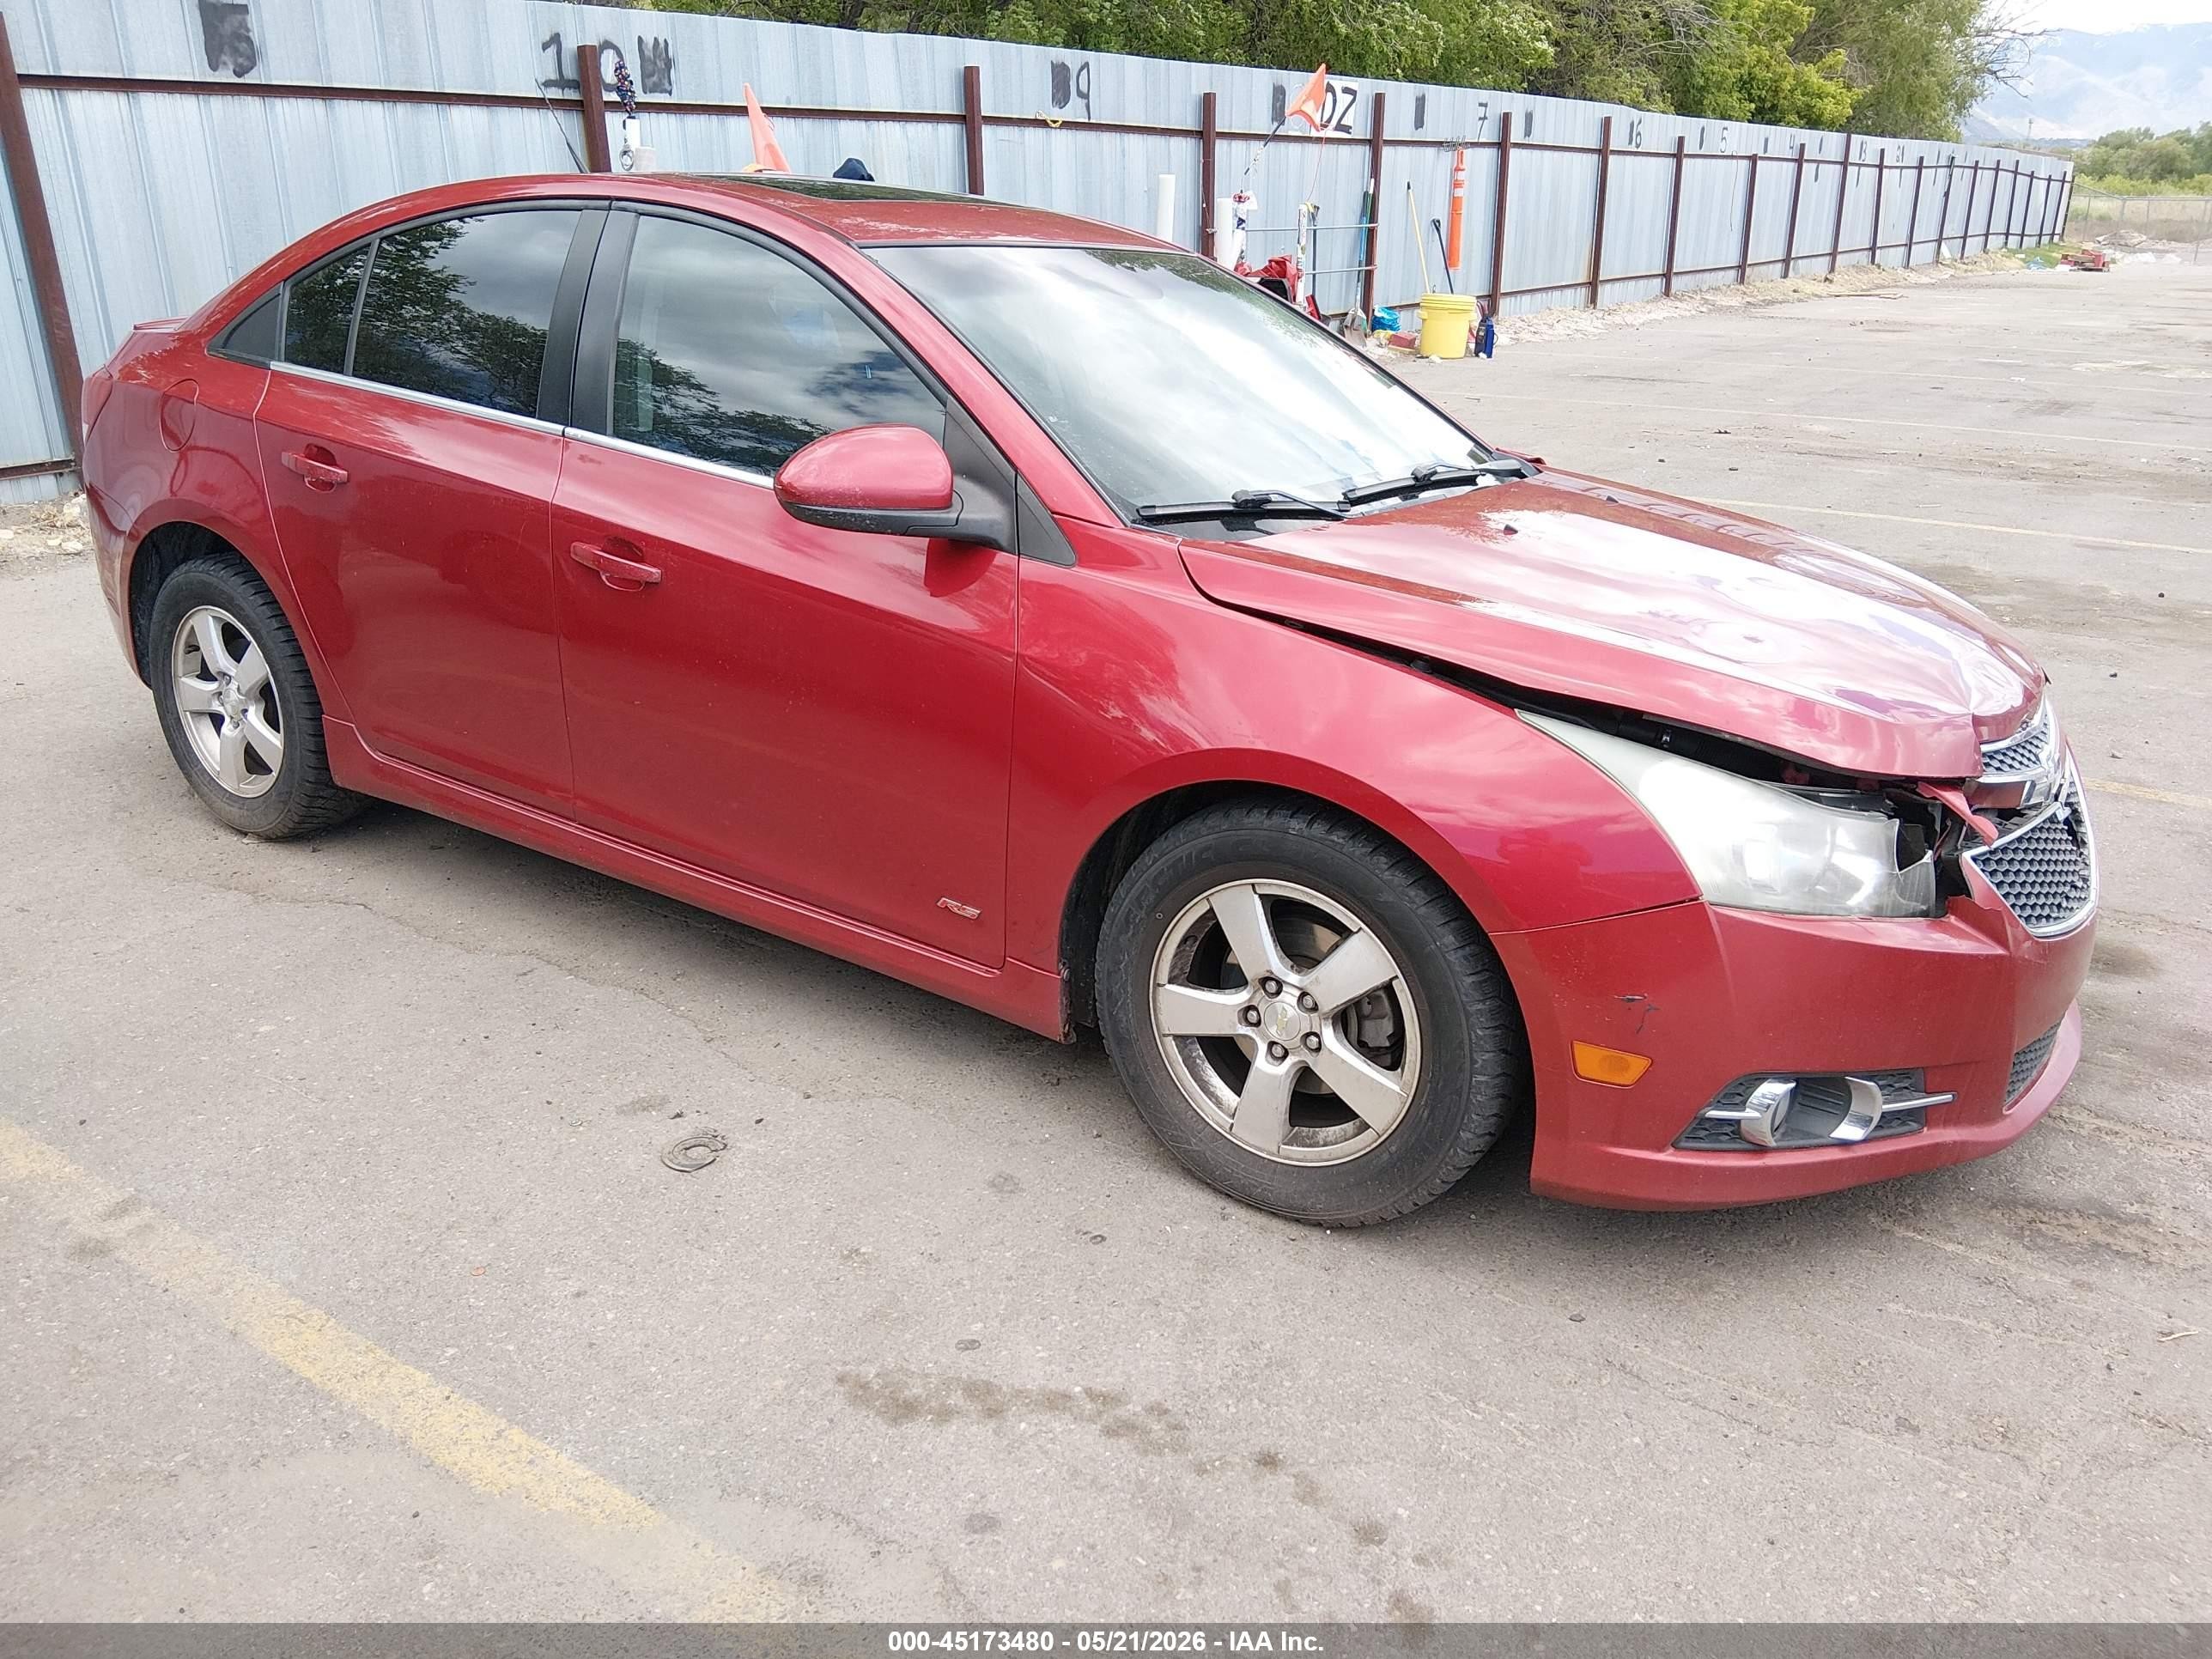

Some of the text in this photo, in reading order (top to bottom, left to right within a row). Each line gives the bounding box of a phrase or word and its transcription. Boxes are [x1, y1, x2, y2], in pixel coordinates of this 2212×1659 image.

[1478, 101, 1489, 142] 7
[1635, 116, 1643, 149] 6
[1720, 126, 1729, 154] 5
[1789, 133, 1796, 156] 4
